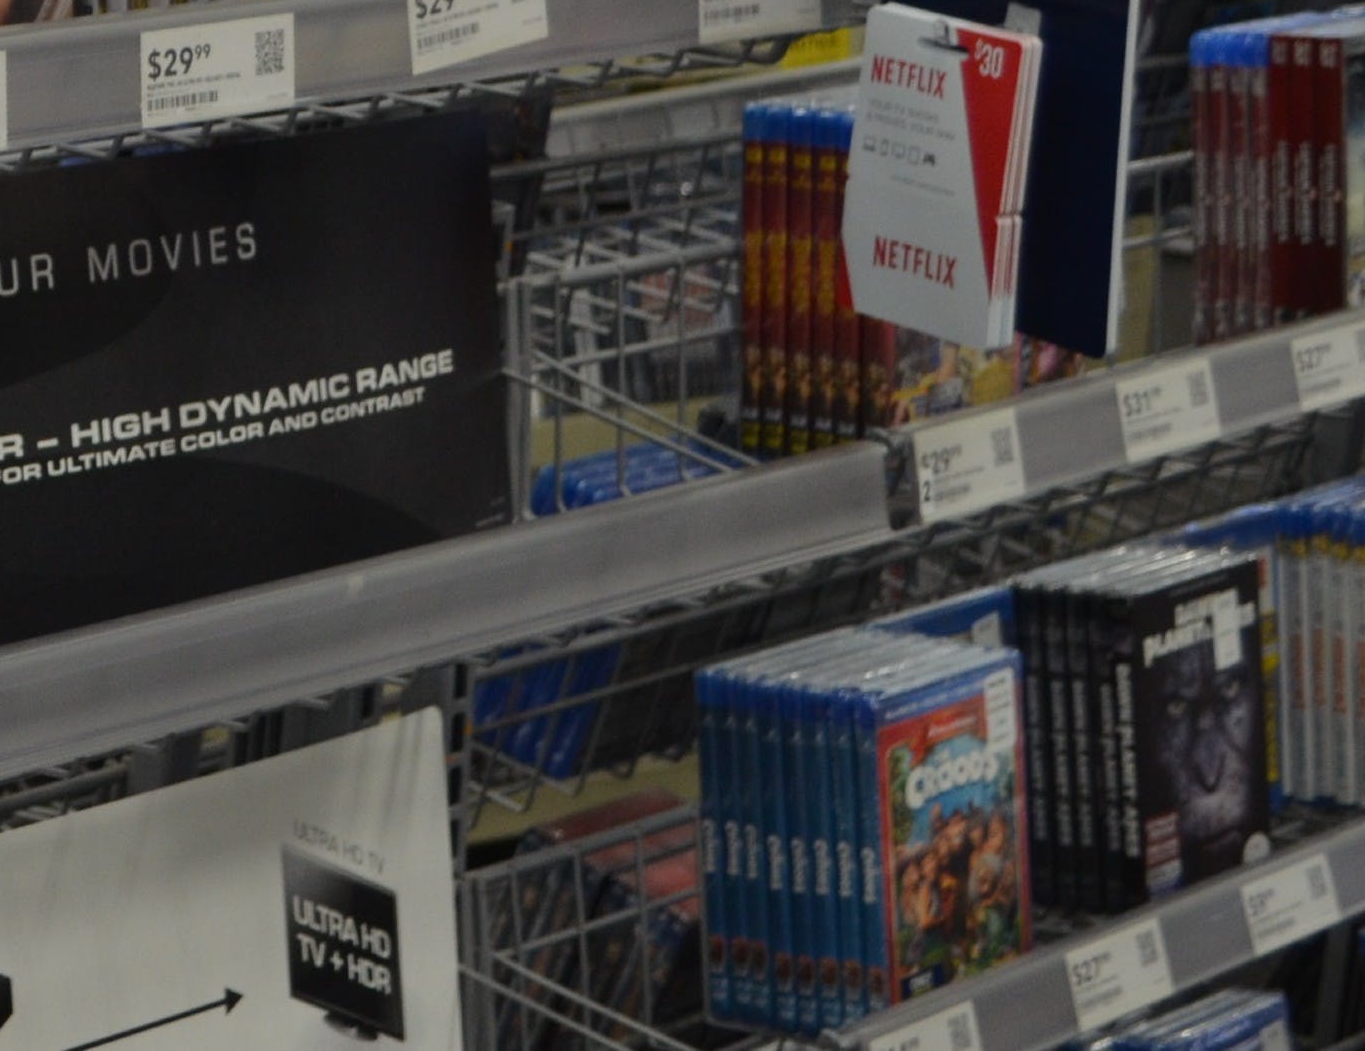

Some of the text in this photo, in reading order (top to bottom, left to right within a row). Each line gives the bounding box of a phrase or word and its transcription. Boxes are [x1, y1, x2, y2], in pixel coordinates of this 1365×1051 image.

[870, 54, 947, 99] NETFLIX
[975, 38, 1005, 79] $30
[87, 221, 261, 284] MOVIES
[872, 234, 959, 290] NETFLIX
[69, 406, 171, 449] HIGH
[179, 372, 350, 429] DYNAMIC
[355, 348, 455, 394] RANGE
[46, 437, 177, 479] ULTIMATE
[180, 418, 265, 452] COLOR
[267, 407, 319, 437] AND
[320, 386, 427, 425] CONTRAST
[292, 895, 392, 960] ULTRA HD
[296, 932, 327, 969] TV
[347, 953, 393, 995] HDR
